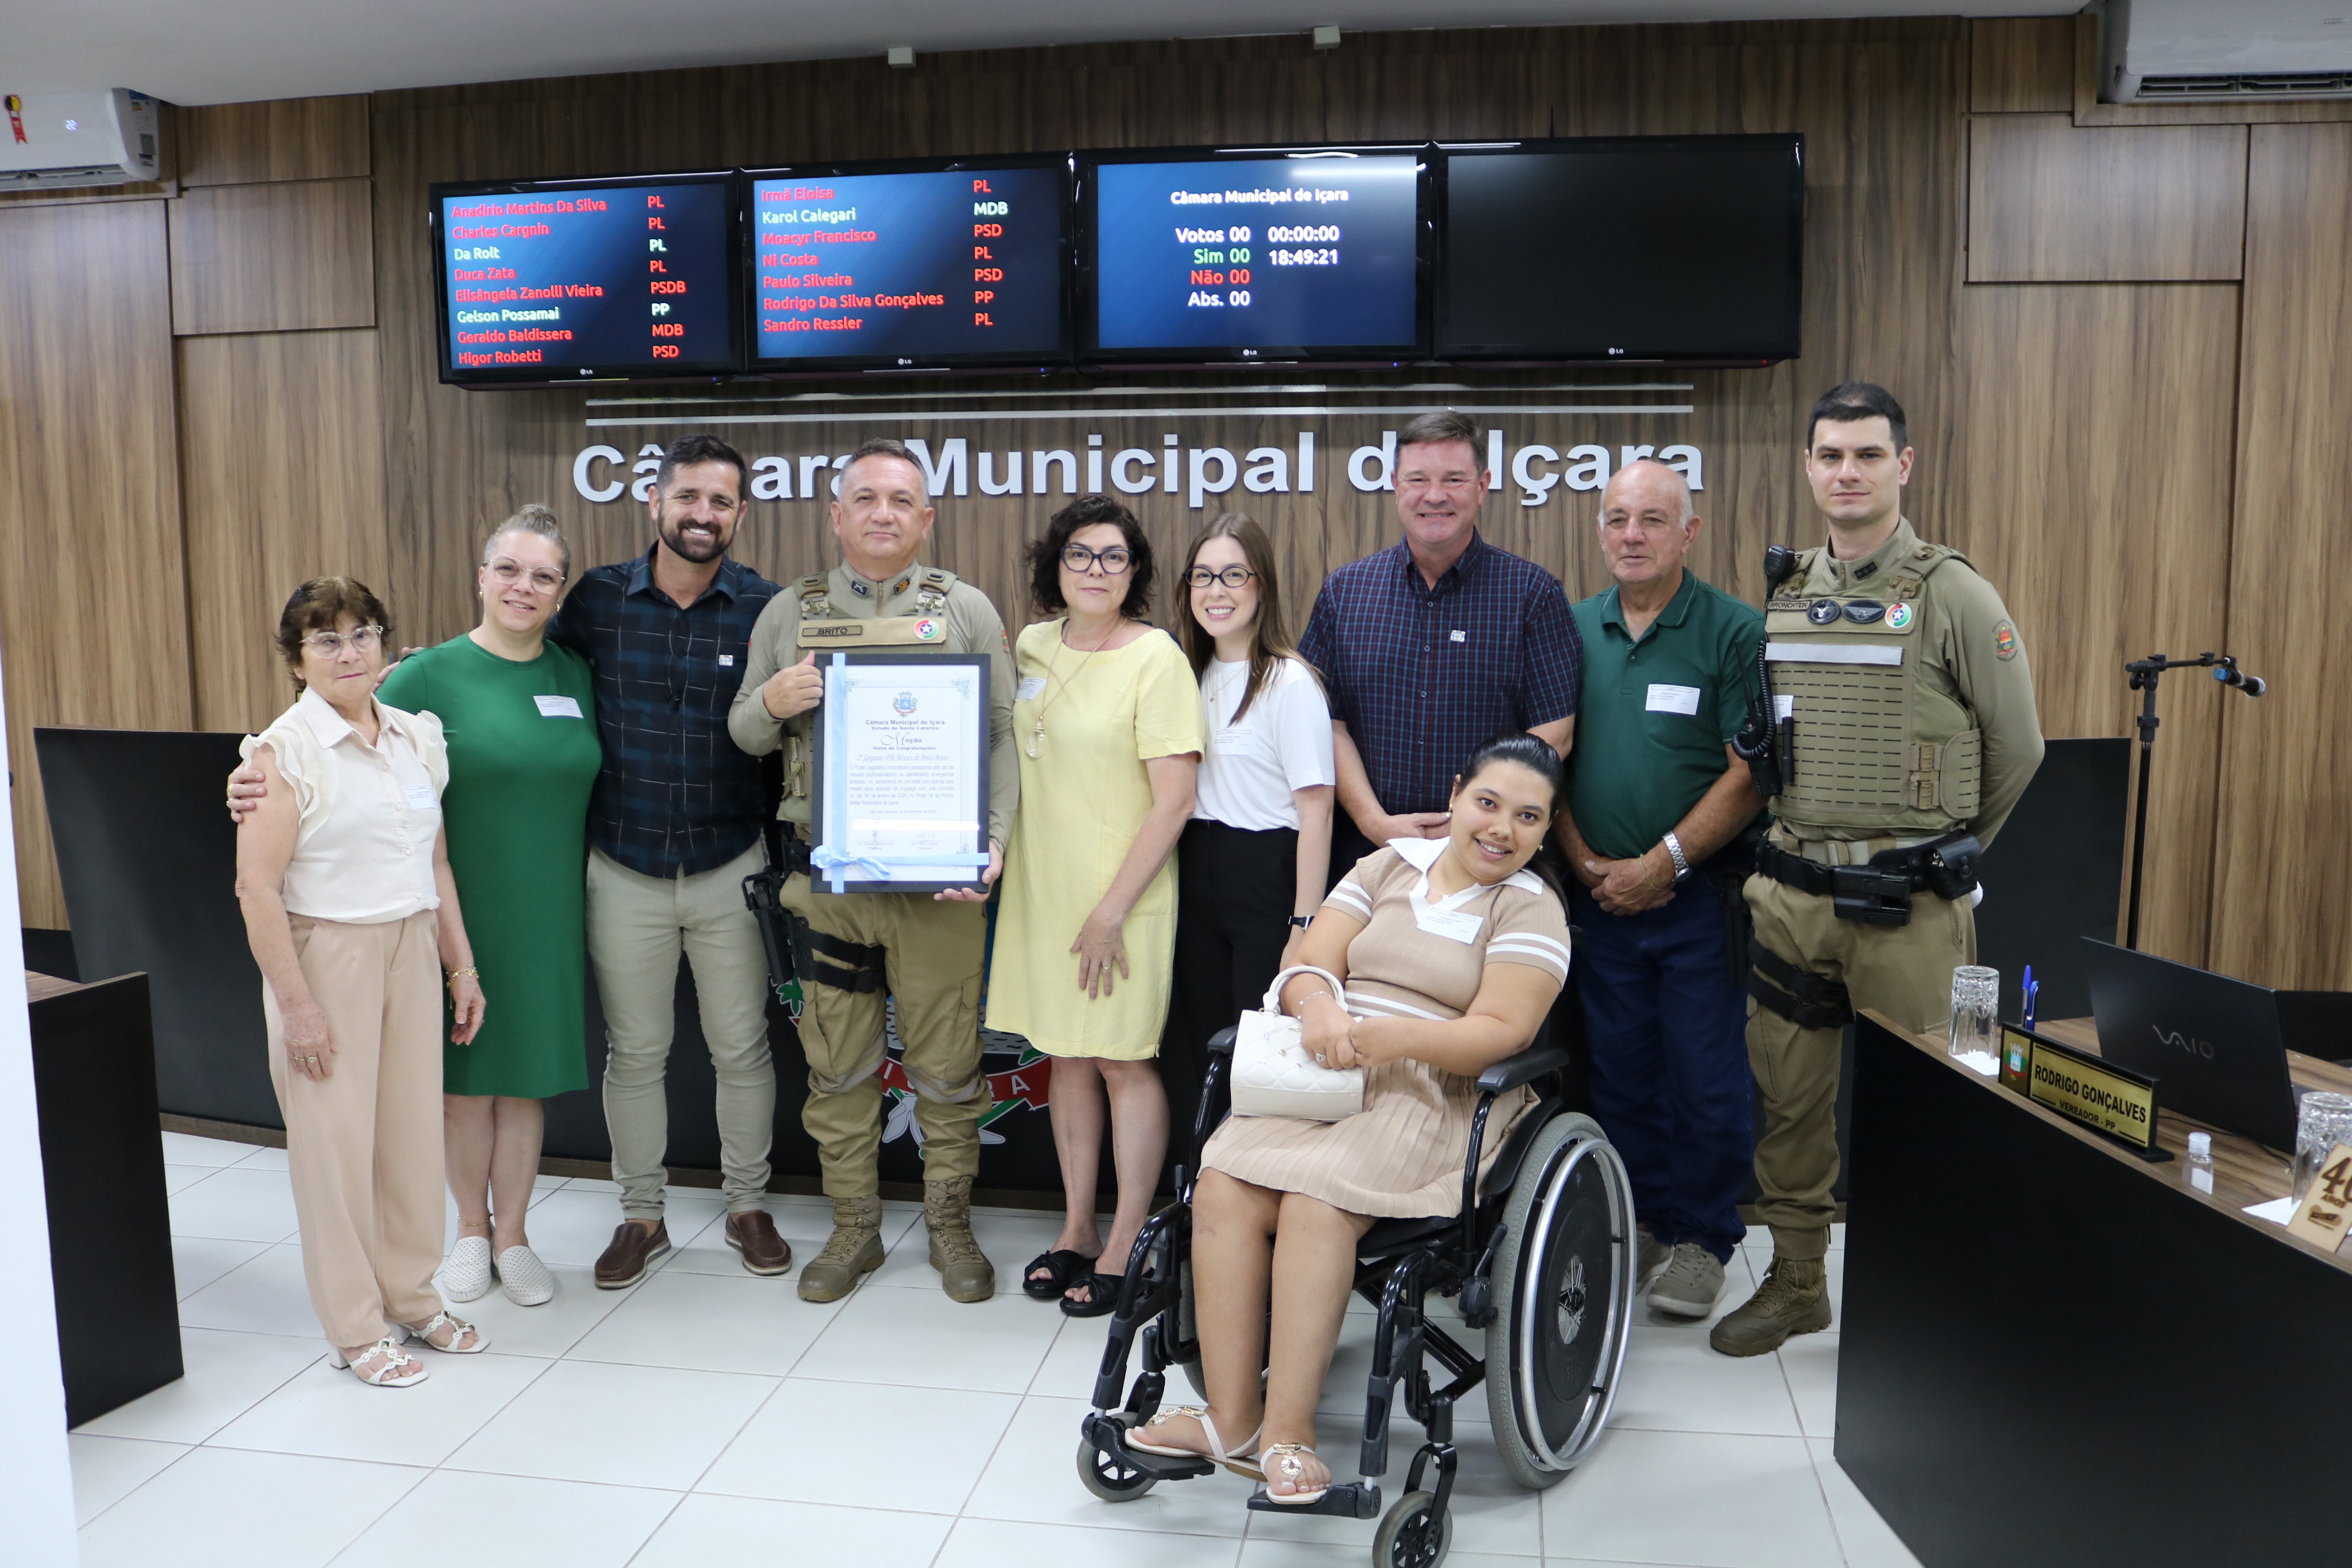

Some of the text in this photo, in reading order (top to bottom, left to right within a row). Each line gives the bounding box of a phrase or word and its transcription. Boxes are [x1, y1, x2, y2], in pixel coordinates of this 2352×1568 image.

[974, 180, 991, 192] PL
[648, 196, 665, 208] PL
[762, 188, 834, 202] Irmã Eloisa
[1171, 188, 1348, 204] Câmara Municipal de Içara
[452, 198, 607, 218] Anadirio Martins Da Silva
[974, 202, 1008, 215] MDB
[762, 208, 855, 224] Karol Calegari
[648, 217, 665, 230] PL
[452, 223, 550, 239] Charles Cargnin
[974, 225, 1002, 237] PSD
[1175, 226, 1340, 243] Votos 00 00:00:00
[649, 239, 667, 251] PL
[762, 230, 876, 247] Moacyr Francisco
[454, 247, 500, 260] Da Rolt
[763, 253, 818, 266] Ni Costa
[975, 247, 992, 259] PL
[1194, 248, 1338, 264] Sim 00 18:49:21
[650, 260, 667, 273] PL
[455, 267, 515, 281] Duca Zata
[763, 274, 852, 288] Paulo Silveira
[975, 269, 1003, 282] PSD
[1191, 269, 1250, 285] Não 00
[455, 284, 603, 303] Elisângela Zanolli Vieira
[651, 281, 686, 293] PSDB
[764, 293, 943, 313] Rodrigo Da Silva Gonçalves
[975, 291, 993, 303] PP
[1188, 291, 1250, 306] Abs. 00
[457, 307, 559, 323] Gelson Possamai
[652, 303, 669, 315] PP
[764, 316, 862, 332] Sandro Ressler
[975, 313, 992, 326] PL
[458, 329, 572, 344] Geraldo Baldissera
[652, 324, 683, 337] MDB
[459, 349, 541, 365] Higor Robetti
[653, 345, 679, 357] PSD
[573, 443, 853, 502] Câar
[905, 431, 1315, 507] Municipal
[1348, 430, 1397, 491] d
[881, 732, 922, 745] Moção
[2152, 1025, 2213, 1059] VAIO
[2035, 1064, 2146, 1123] RODRIGO GONÇALVES
[2060, 1100, 2099, 1123] VEREADOR
[2106, 1119, 2115, 1130] PP
